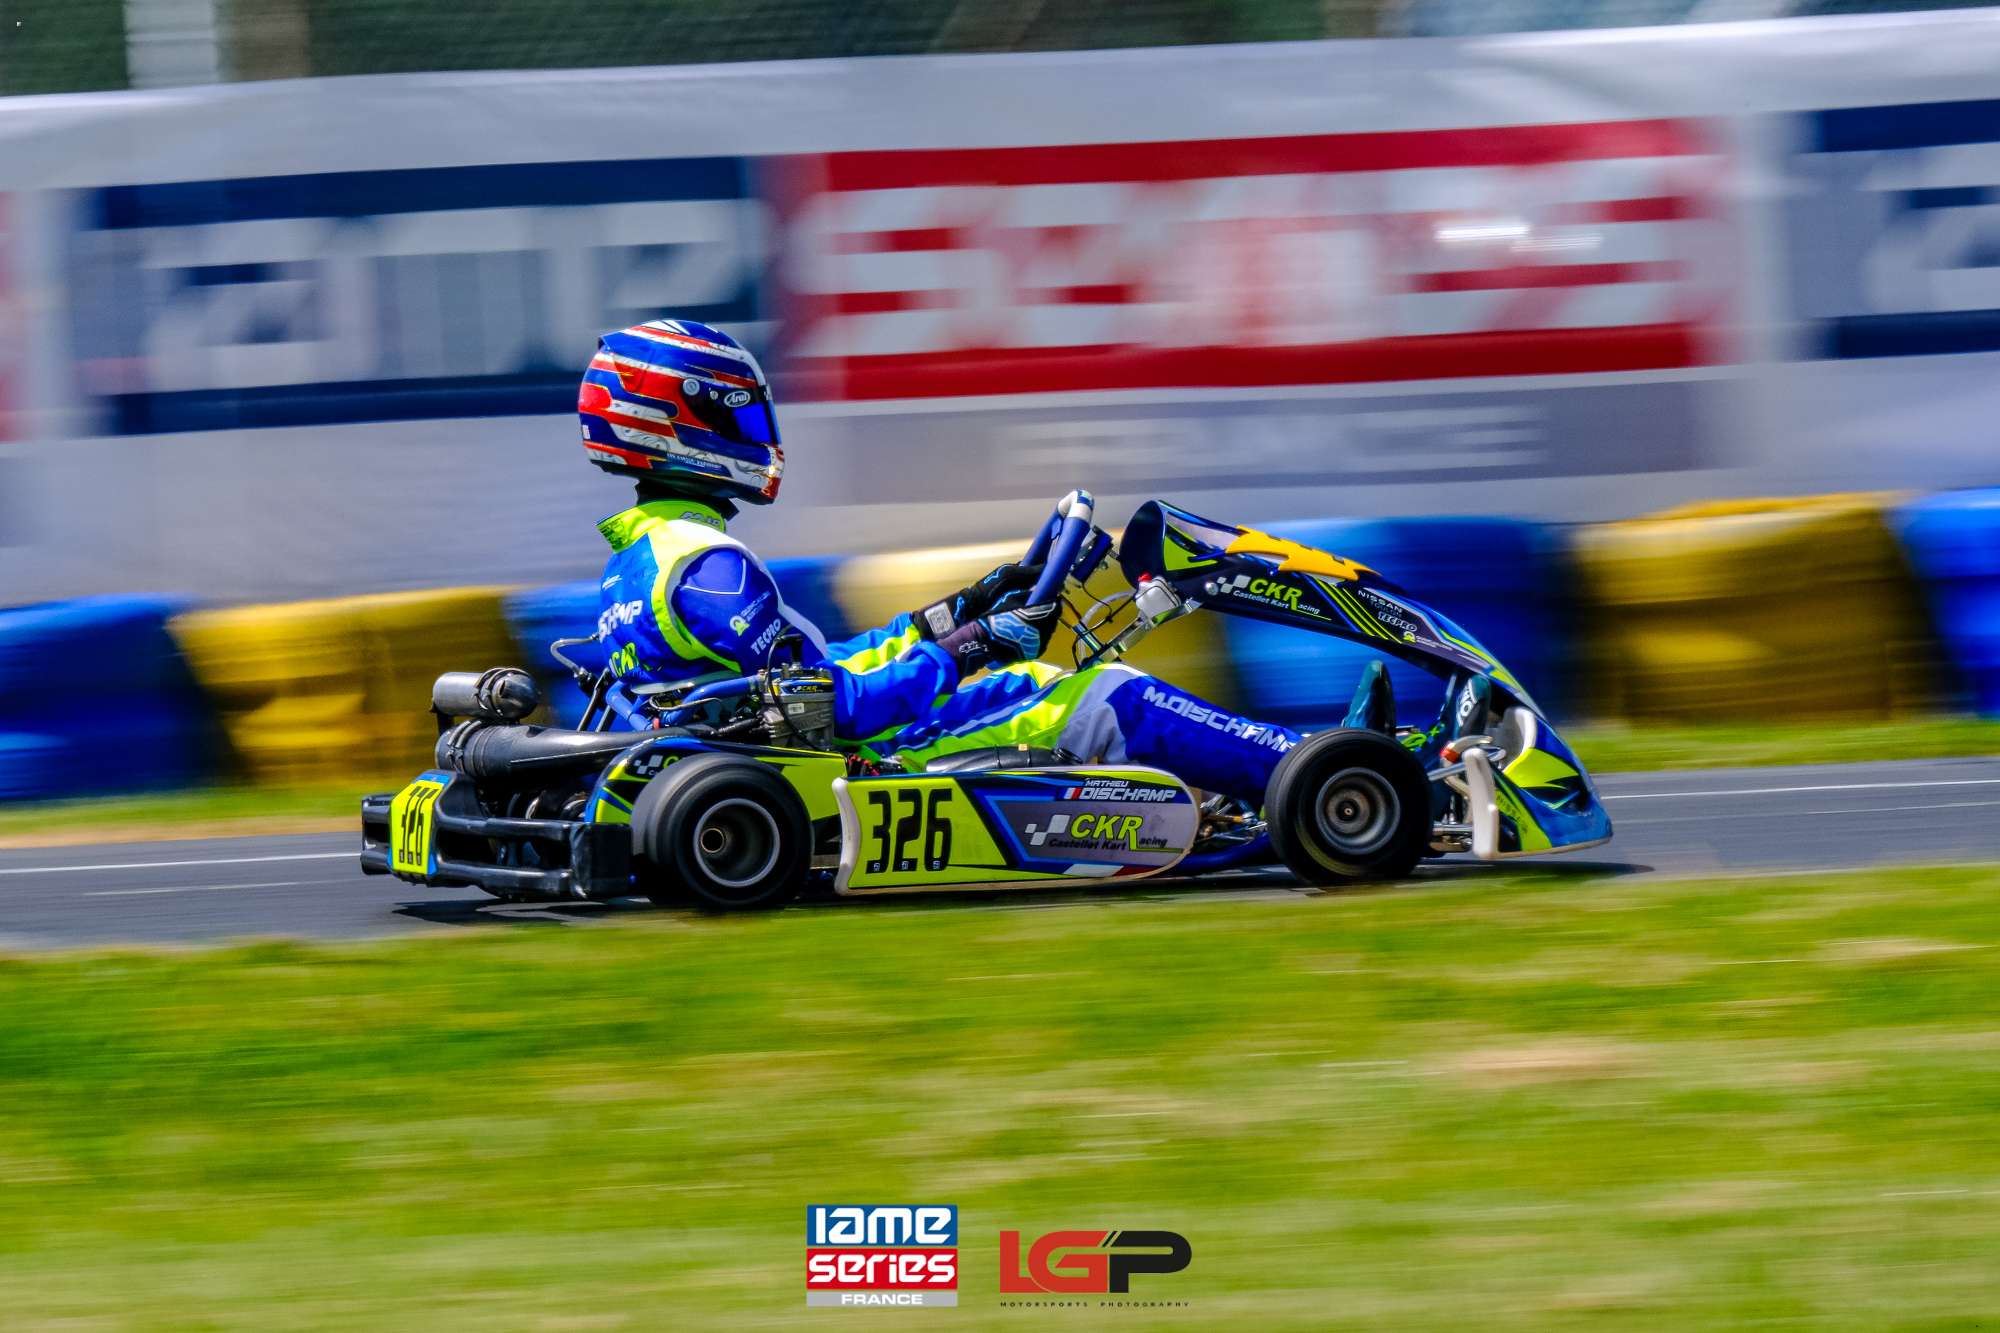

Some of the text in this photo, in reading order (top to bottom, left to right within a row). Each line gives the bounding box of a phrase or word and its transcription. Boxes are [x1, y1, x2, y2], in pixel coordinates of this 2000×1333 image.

[1249, 579, 1302, 611] CKR
[1270, 599, 1289, 609] Kart
[1358, 589, 1403, 613] NISSAN
[1378, 611, 1417, 632] TECPRO
[1085, 779, 1129, 788] MATHIEU
[1080, 788, 1176, 802] DISCHAMP
[865, 788, 952, 874] 326
[1070, 813, 1144, 851] CKR
[1050, 838, 1099, 849] Castellet
[1101, 840, 1127, 850] Kart
